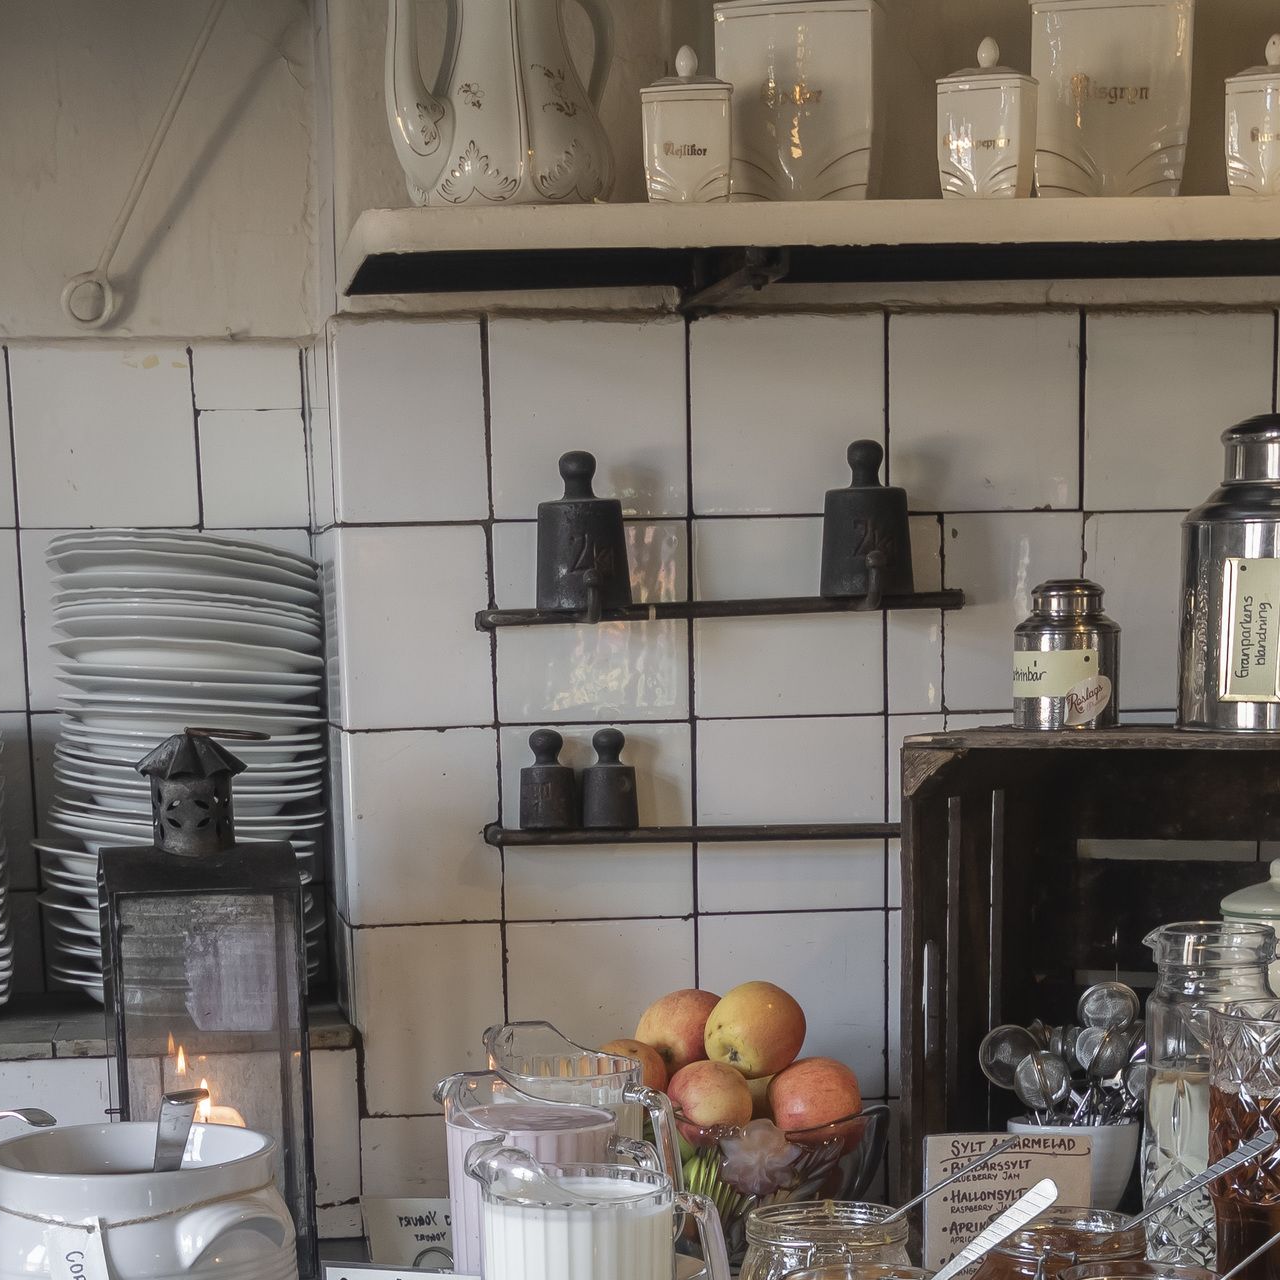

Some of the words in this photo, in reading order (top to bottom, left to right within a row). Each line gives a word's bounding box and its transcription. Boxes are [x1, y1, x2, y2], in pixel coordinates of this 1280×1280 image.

[1234, 595, 1255, 679] Granparkens
[1254, 602, 1273, 667] blandning
[1065, 683, 1104, 714] Roslags
[950, 1139, 986, 1157] SYLT
[1002, 1171, 1020, 1181] JAM
[949, 1187, 1029, 1204] HALLONSYLT
[950, 1204, 994, 1214] RASPBERRY
[996, 1202, 1012, 1212] JA
